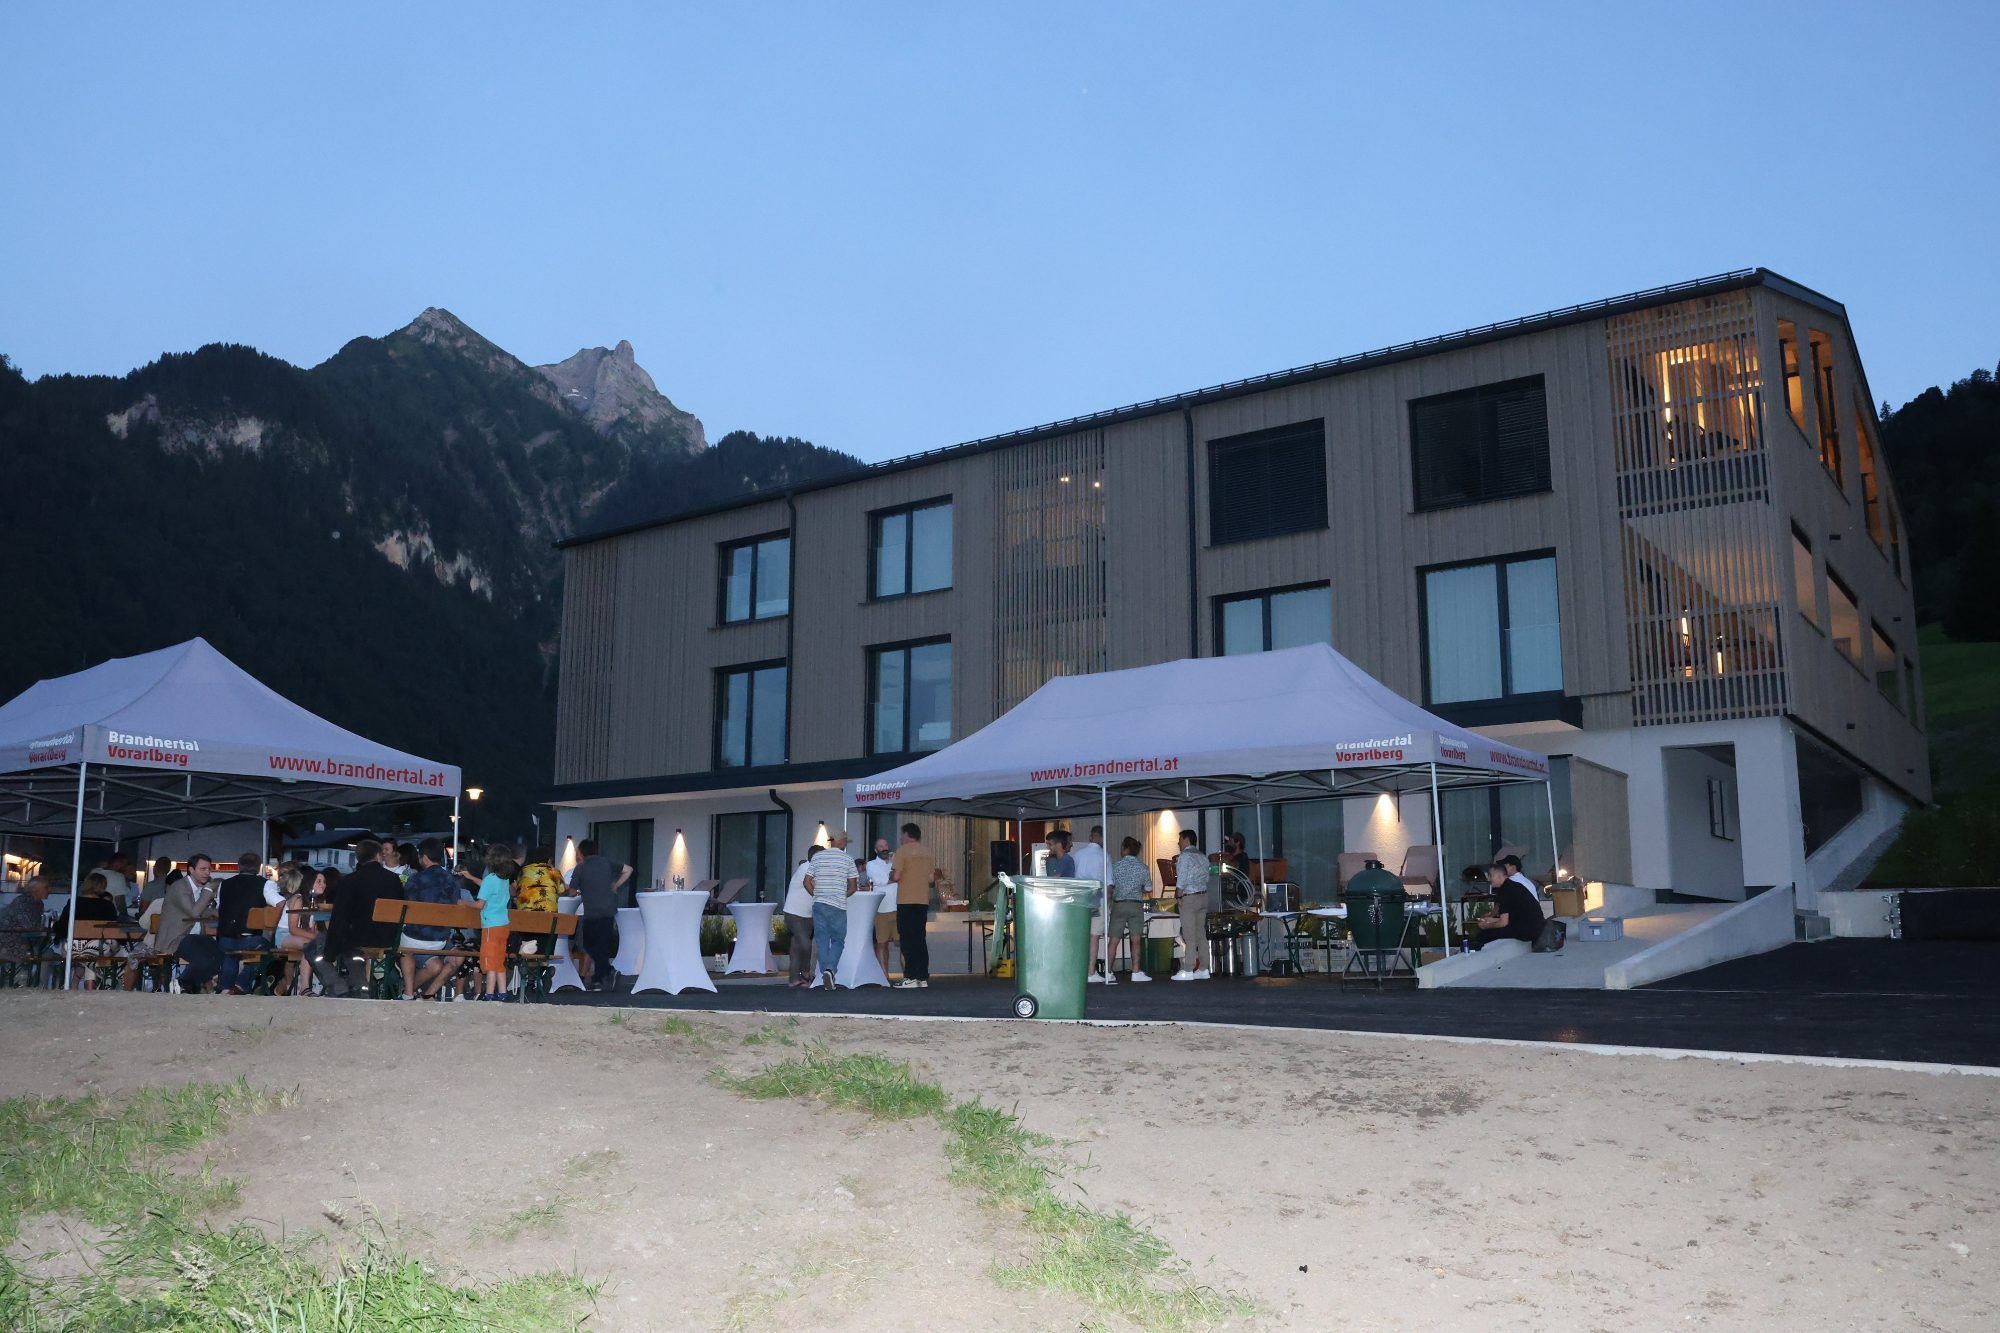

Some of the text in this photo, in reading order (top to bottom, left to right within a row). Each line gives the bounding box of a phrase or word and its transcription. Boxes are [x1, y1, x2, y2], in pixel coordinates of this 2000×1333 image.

[108, 731, 200, 751] Brandnertal
[108, 745, 189, 767] Vorarlberg
[1335, 748, 1404, 763] Vorarlberg
[269, 755, 445, 788] www.brandnertal.at
[1030, 756, 1179, 782] www.brandnertal.at
[855, 790, 902, 802] Vorarlberg
[856, 780, 910, 793] Brandnertal
